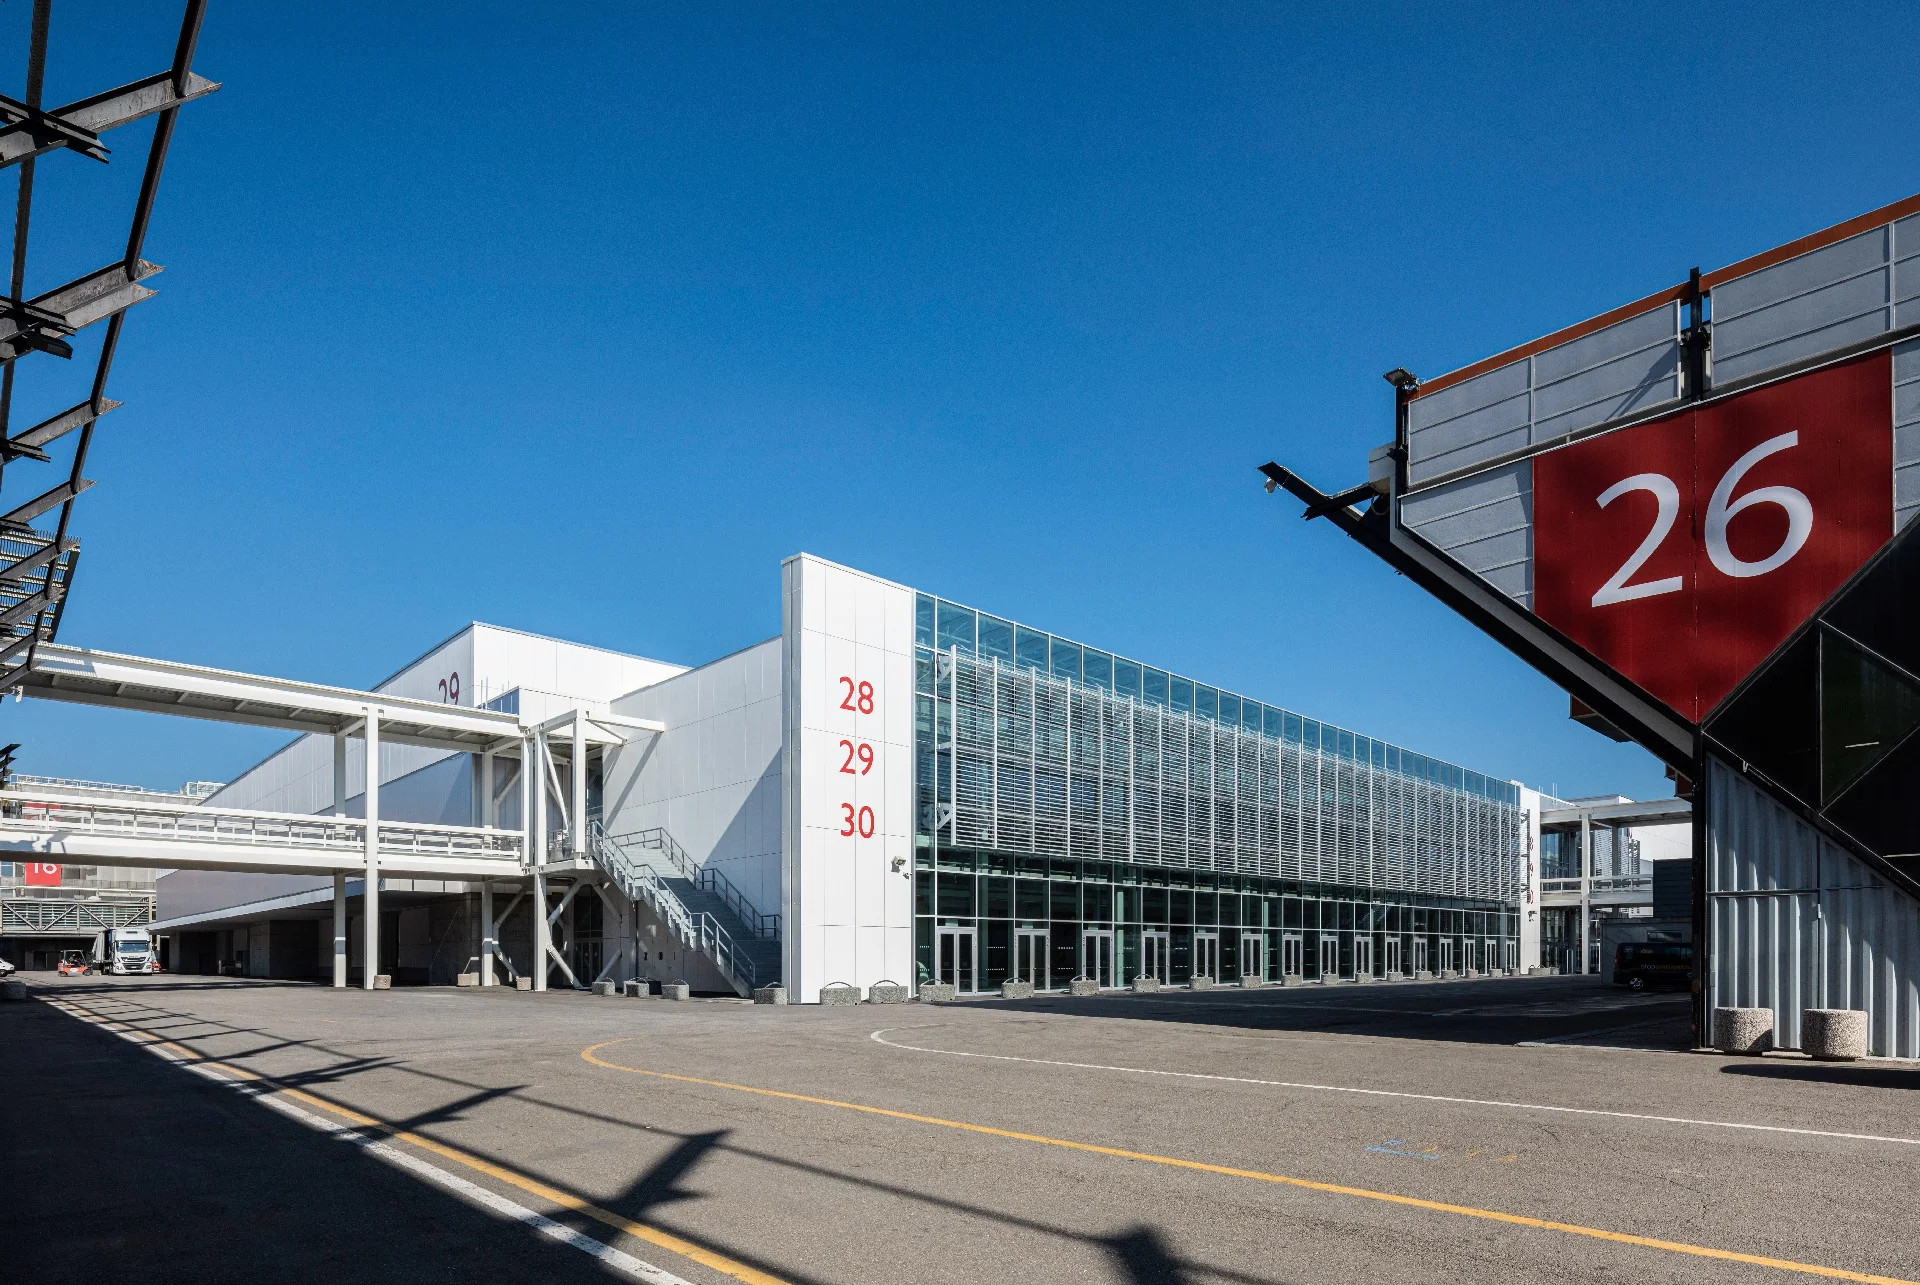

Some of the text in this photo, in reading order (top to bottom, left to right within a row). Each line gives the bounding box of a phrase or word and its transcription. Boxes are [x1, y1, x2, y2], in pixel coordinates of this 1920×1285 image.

[1591, 429, 1814, 608] 26
[439, 671, 460, 705] 29
[839, 676, 874, 715] 28
[839, 739, 874, 776] 29
[840, 802, 875, 839] 30
